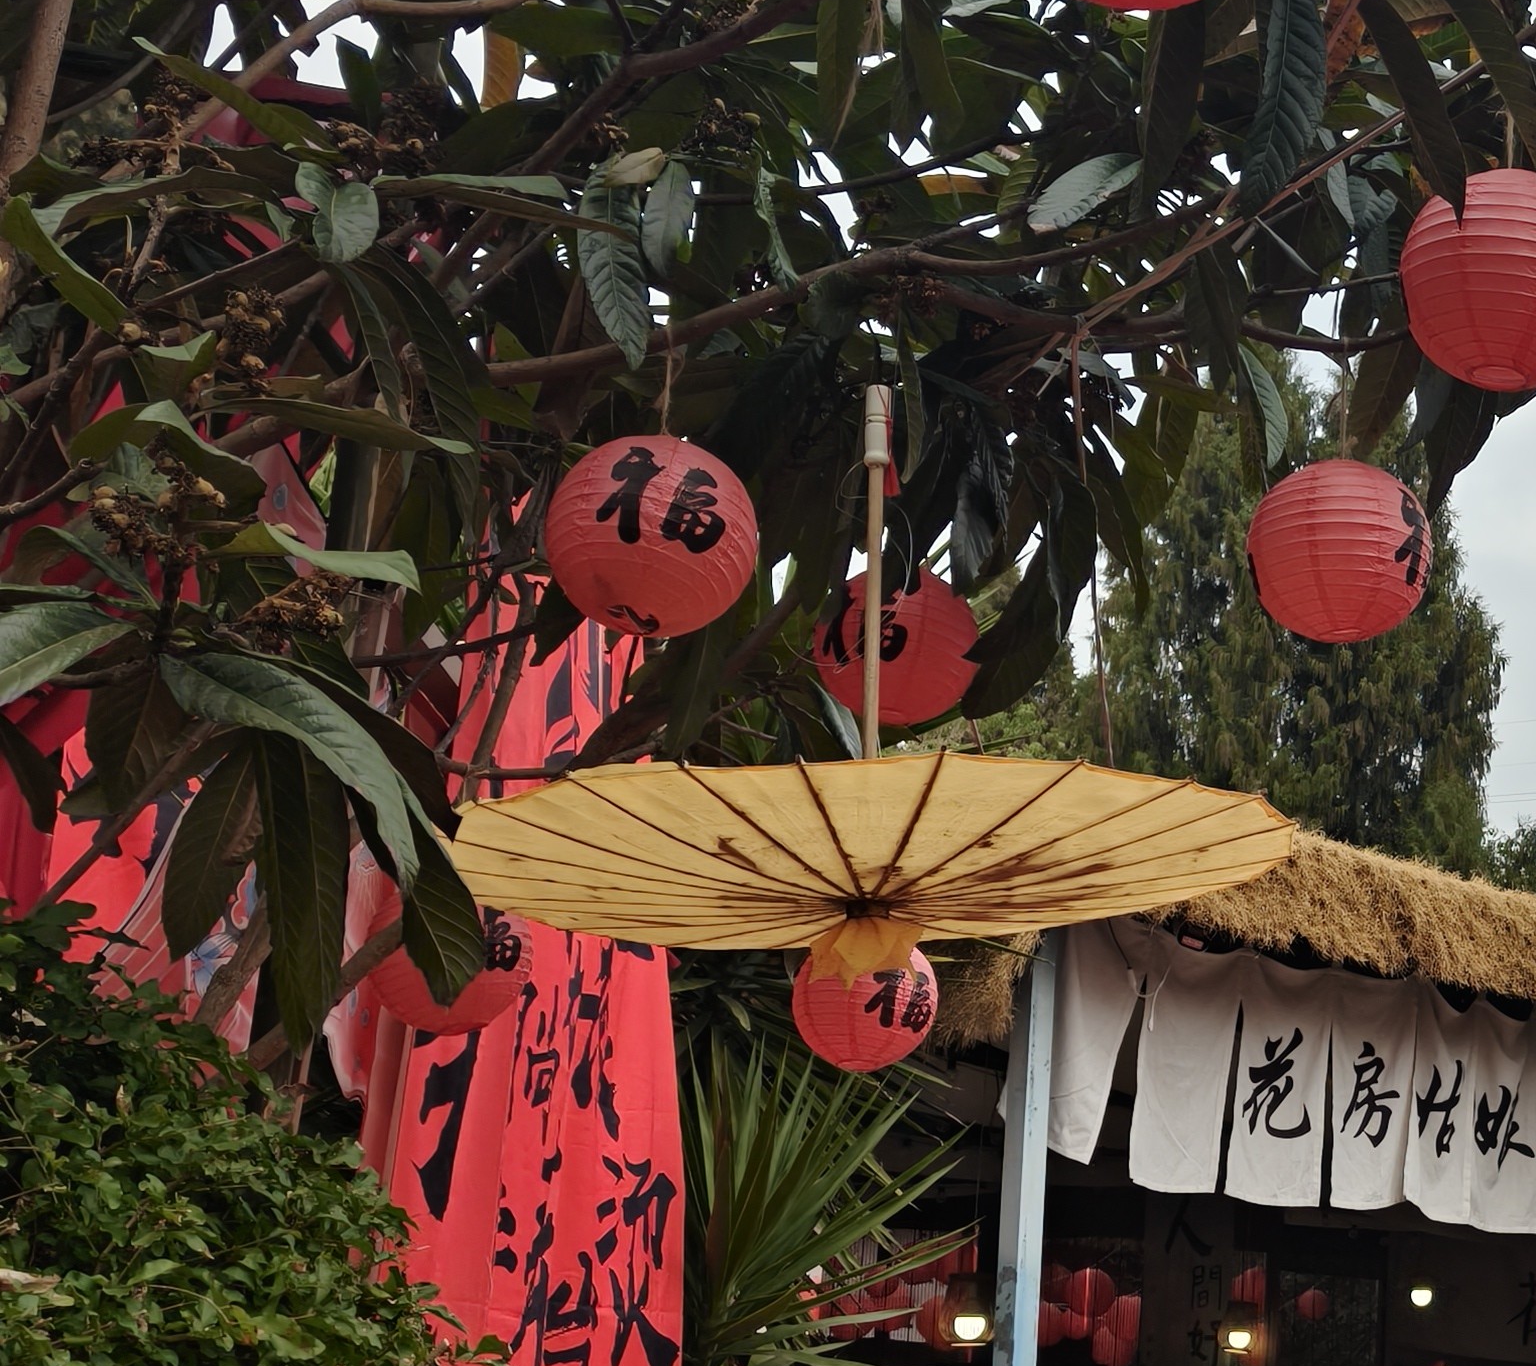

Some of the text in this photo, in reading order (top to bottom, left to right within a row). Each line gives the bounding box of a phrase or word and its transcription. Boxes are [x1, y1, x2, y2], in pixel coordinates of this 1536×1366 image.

[596, 446, 727, 555] 福
[864, 968, 939, 1035] 福
[1242, 1026, 1536, 1170] 花房姑娘
